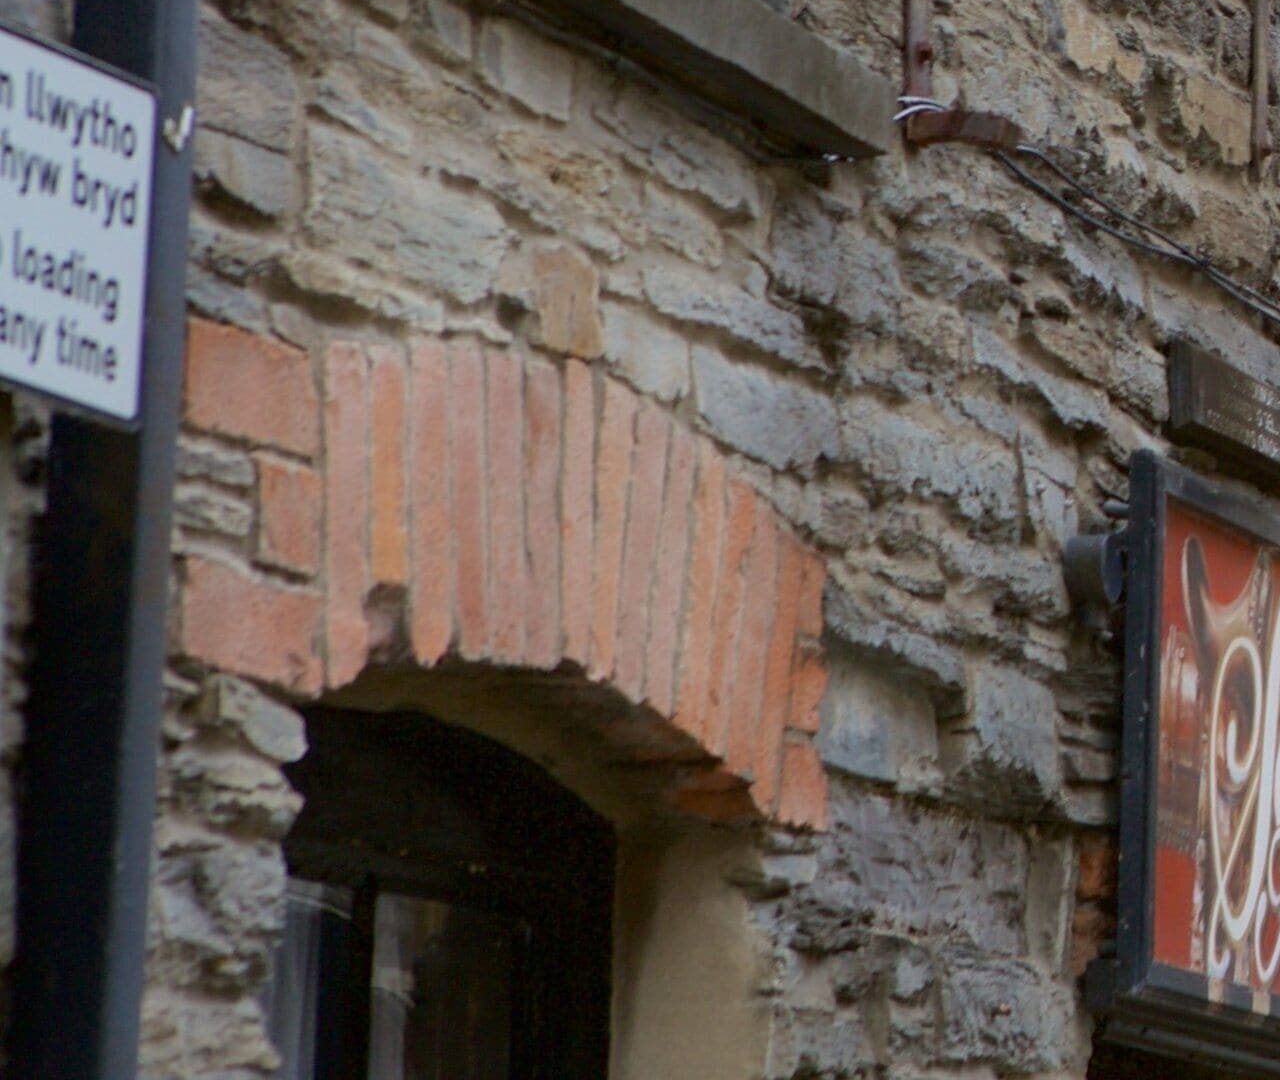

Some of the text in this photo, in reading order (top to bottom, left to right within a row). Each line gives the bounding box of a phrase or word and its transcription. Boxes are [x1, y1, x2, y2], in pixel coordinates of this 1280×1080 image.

[26, 70, 137, 161] llwytho
[72, 156, 139, 228] bryd
[12, 228, 119, 323] loading
[56, 316, 117, 382] time
